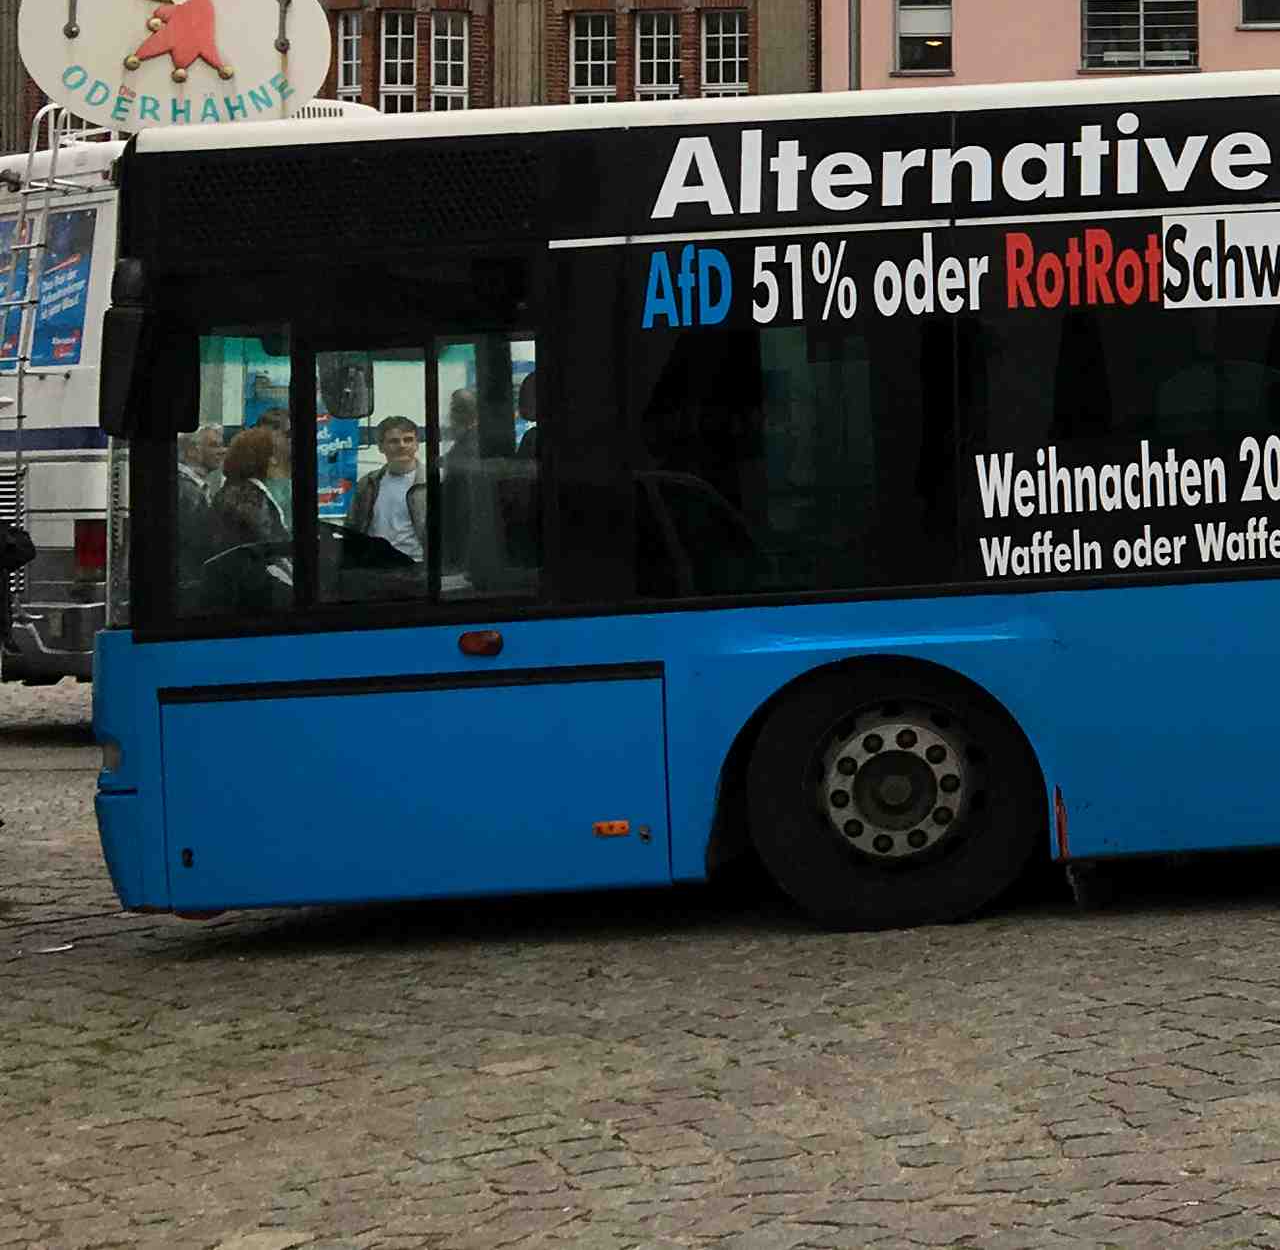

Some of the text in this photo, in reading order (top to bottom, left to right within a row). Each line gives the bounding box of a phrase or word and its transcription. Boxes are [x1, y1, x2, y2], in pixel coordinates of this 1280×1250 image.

[62, 64, 296, 123] ODERHÄHNE
[650, 112, 1272, 219] Alternative
[642, 244, 732, 329] AfD
[752, 240, 857, 324] 51%
[873, 232, 989, 317] oder
[975, 439, 1227, 519] Weihnachten
[979, 529, 1102, 577] Waffeln
[1113, 524, 1187, 569] oder
